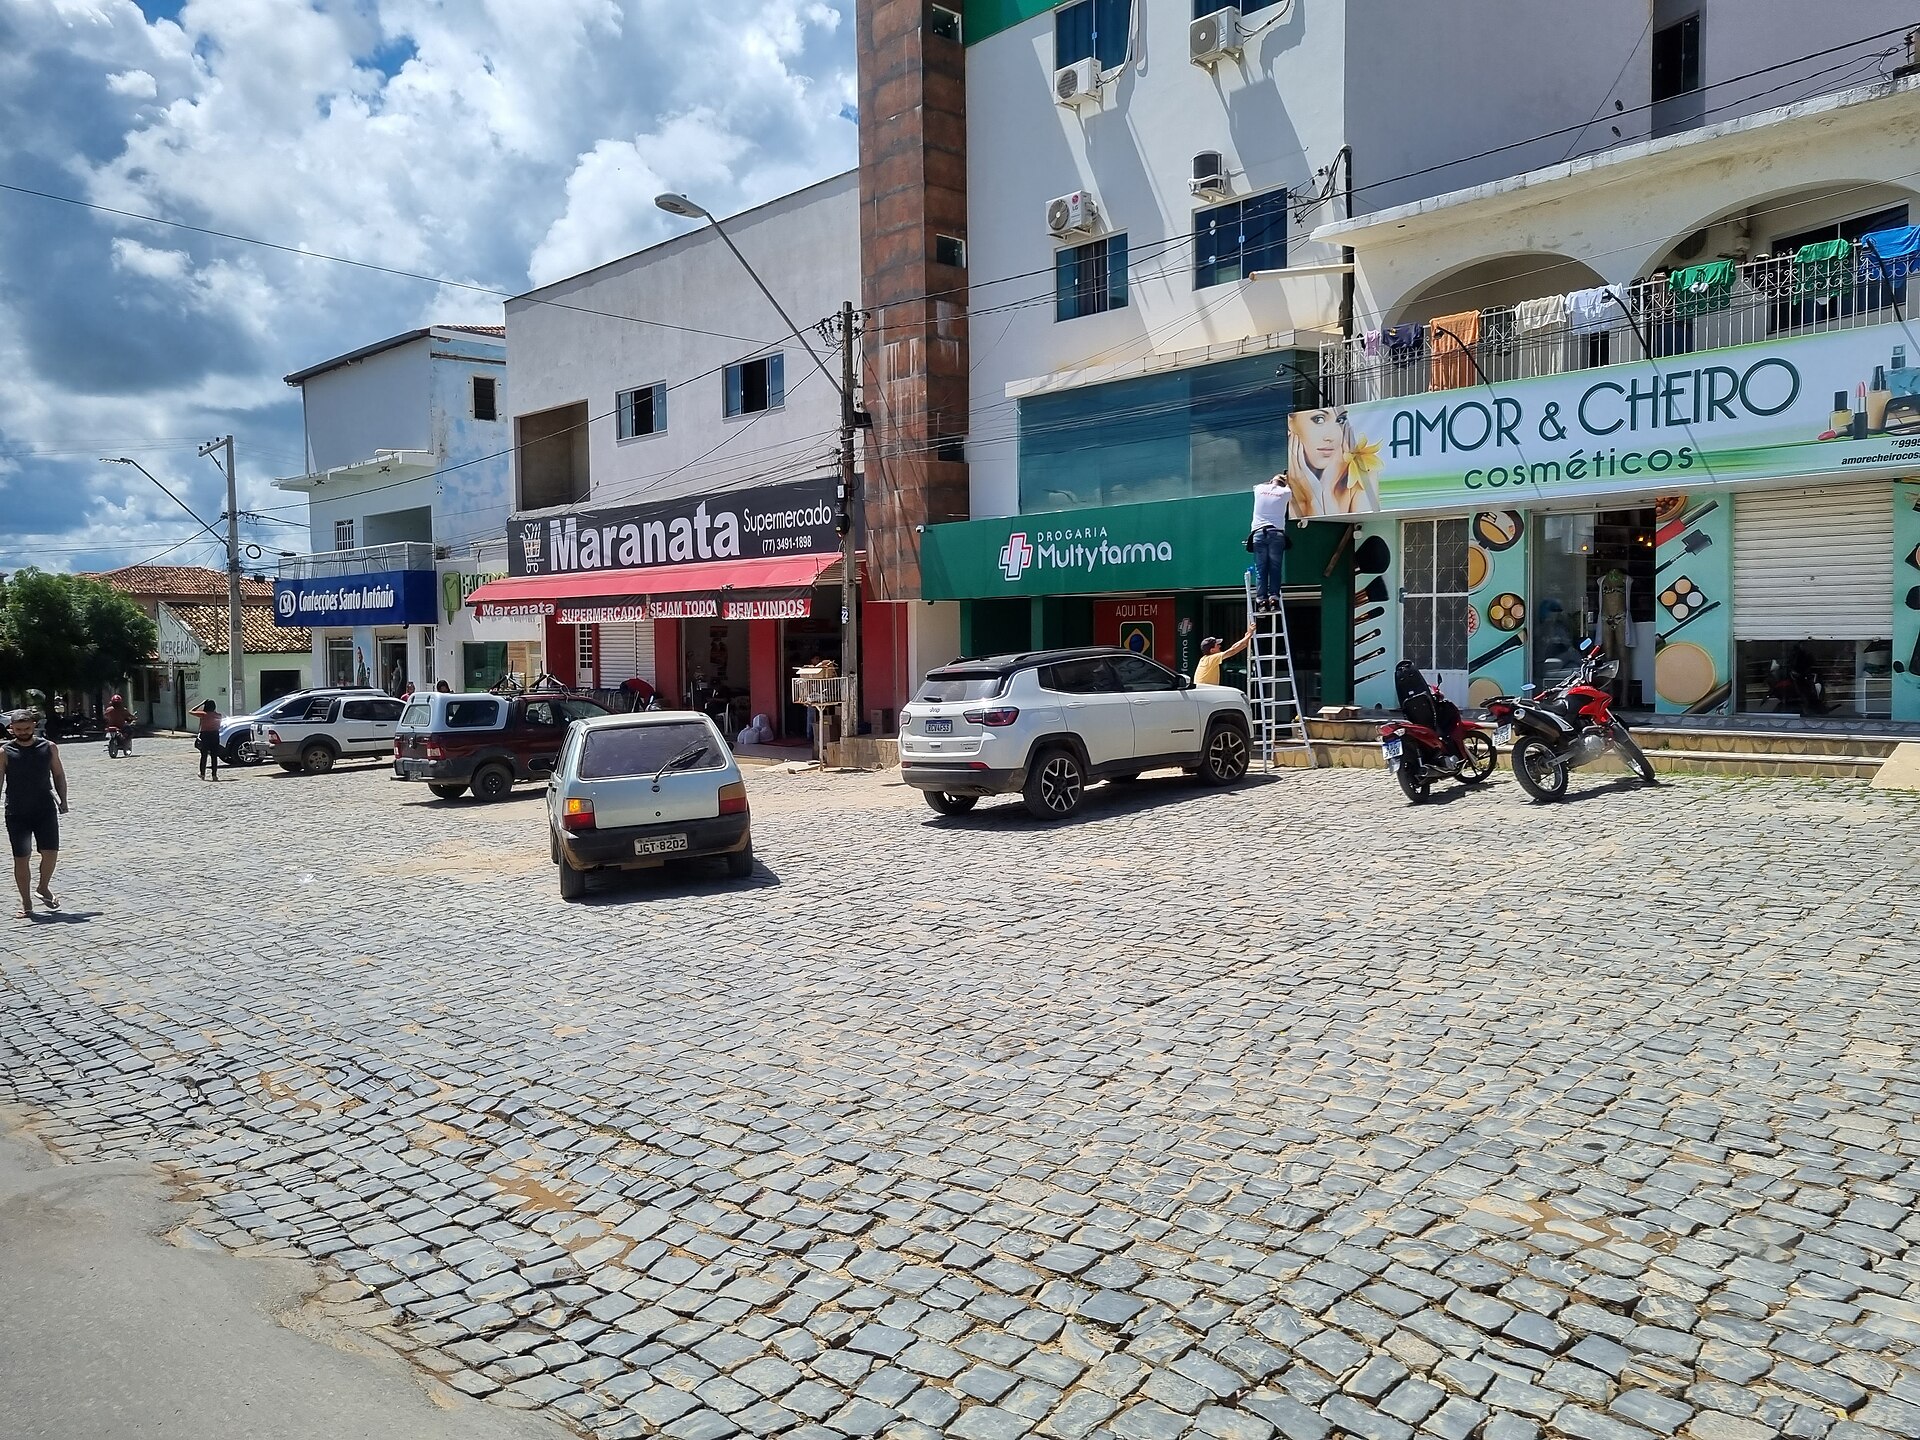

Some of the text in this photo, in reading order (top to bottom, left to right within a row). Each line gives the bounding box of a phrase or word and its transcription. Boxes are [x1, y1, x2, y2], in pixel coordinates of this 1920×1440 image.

[1388, 358, 1802, 459] AMOR & CHEIRO
[1464, 445, 1694, 489] cosméticos
[1841, 451, 1920, 465] amorecheirocos
[550, 499, 832, 571] Maranata Supermercado
[1037, 526, 1108, 543] DROGARIA
[762, 535, 812, 554] (77) 3491-1898
[1037, 540, 1172, 572] Multyfarma
[279, 583, 394, 615] CSA Confecções Santo Antônio
[482, 602, 555, 616] Maranata
[562, 606, 643, 622] SUPERMERCADO
[650, 601, 682, 617] SEJAM
[728, 599, 805, 618] BEM-VINDOS
[1115, 604, 1158, 617] AQUI TEM
[637, 839, 686, 853] JGT-8202
